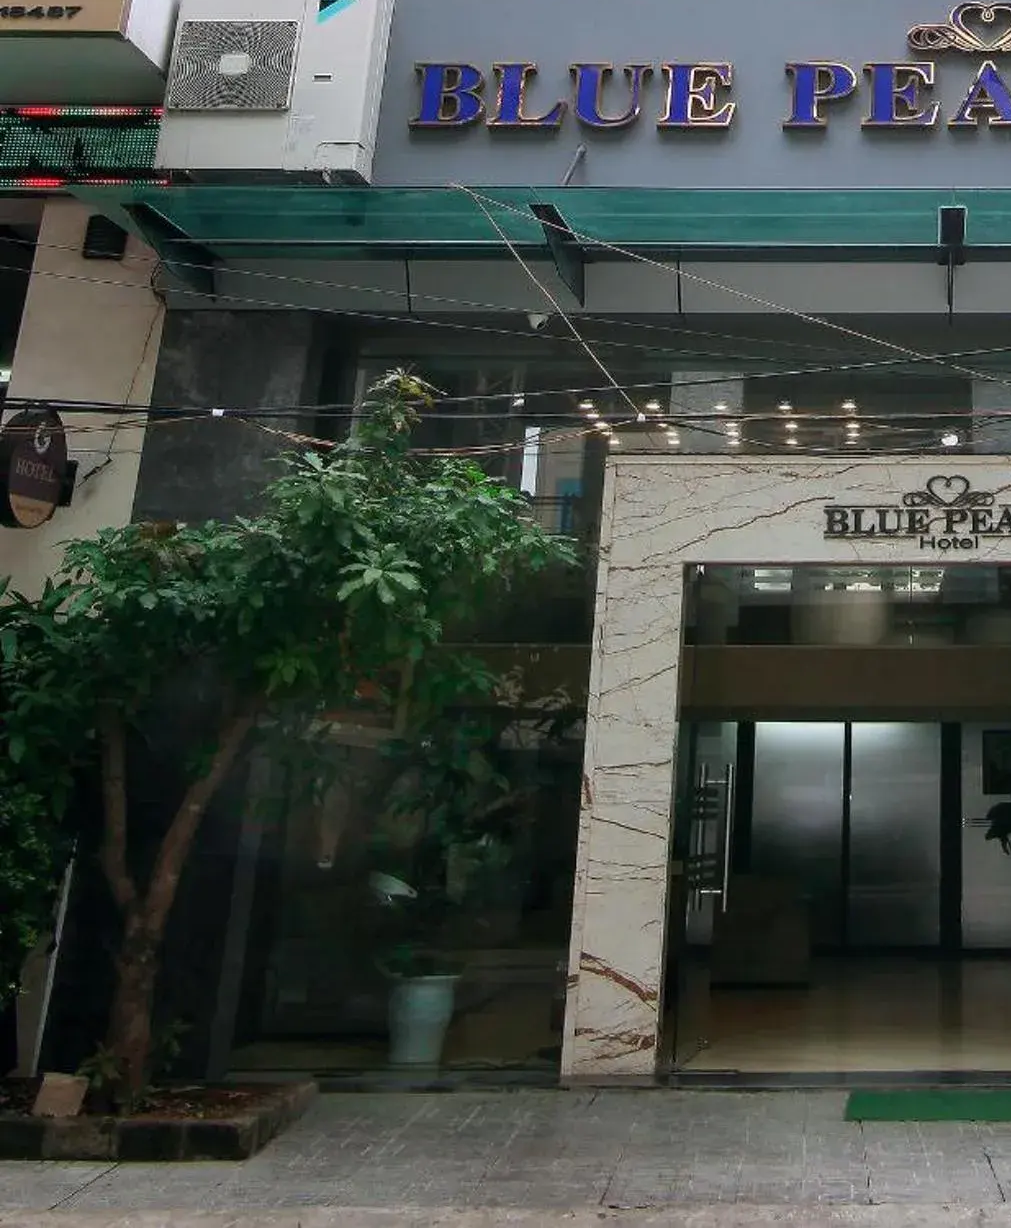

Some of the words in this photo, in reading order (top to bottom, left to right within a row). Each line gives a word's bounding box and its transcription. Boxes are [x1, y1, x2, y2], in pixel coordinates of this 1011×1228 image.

[408, 60, 737, 131] BLUE
[823, 507, 931, 535] BLUE
[919, 535, 979, 551] Hotel
